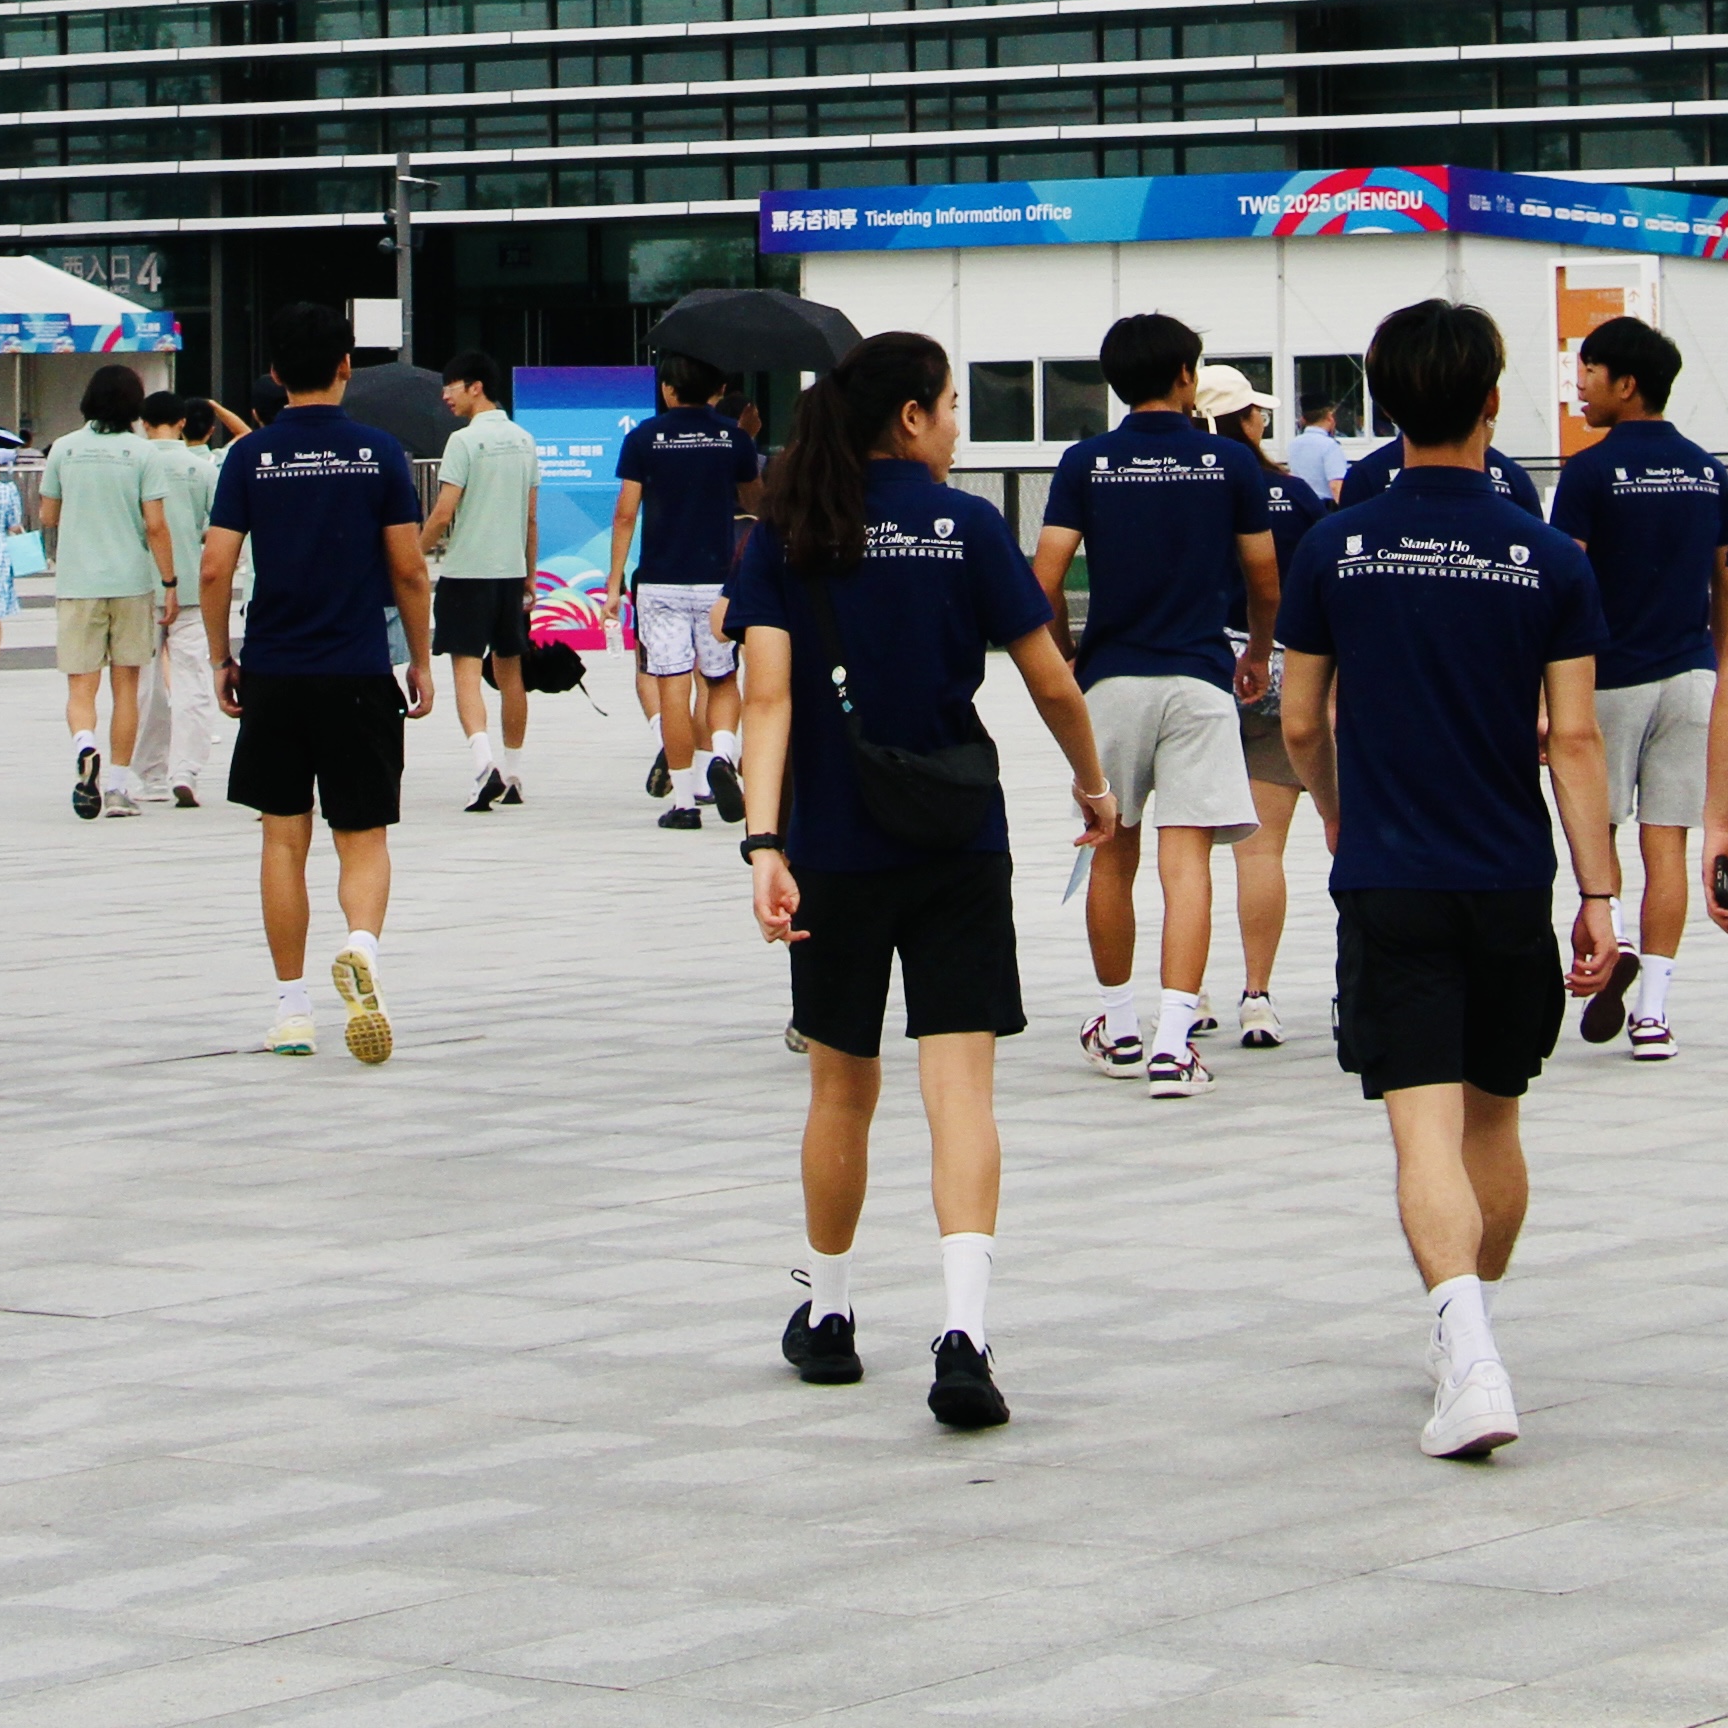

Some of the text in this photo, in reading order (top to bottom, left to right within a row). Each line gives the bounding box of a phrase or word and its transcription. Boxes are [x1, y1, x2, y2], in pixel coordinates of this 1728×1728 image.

[1238, 190, 1423, 215] TWG 2025 CHENGDU
[771, 208, 858, 232] 票务咨询亭
[865, 203, 1072, 228] Ticketing Information Office
[63, 252, 162, 292] 西入口 4
[880, 521, 898, 533] Ho
[879, 532, 919, 546] College
[1399, 537, 1470, 553] Stanley Ho
[1377, 548, 1448, 567] Community
[1449, 553, 1492, 569] College
